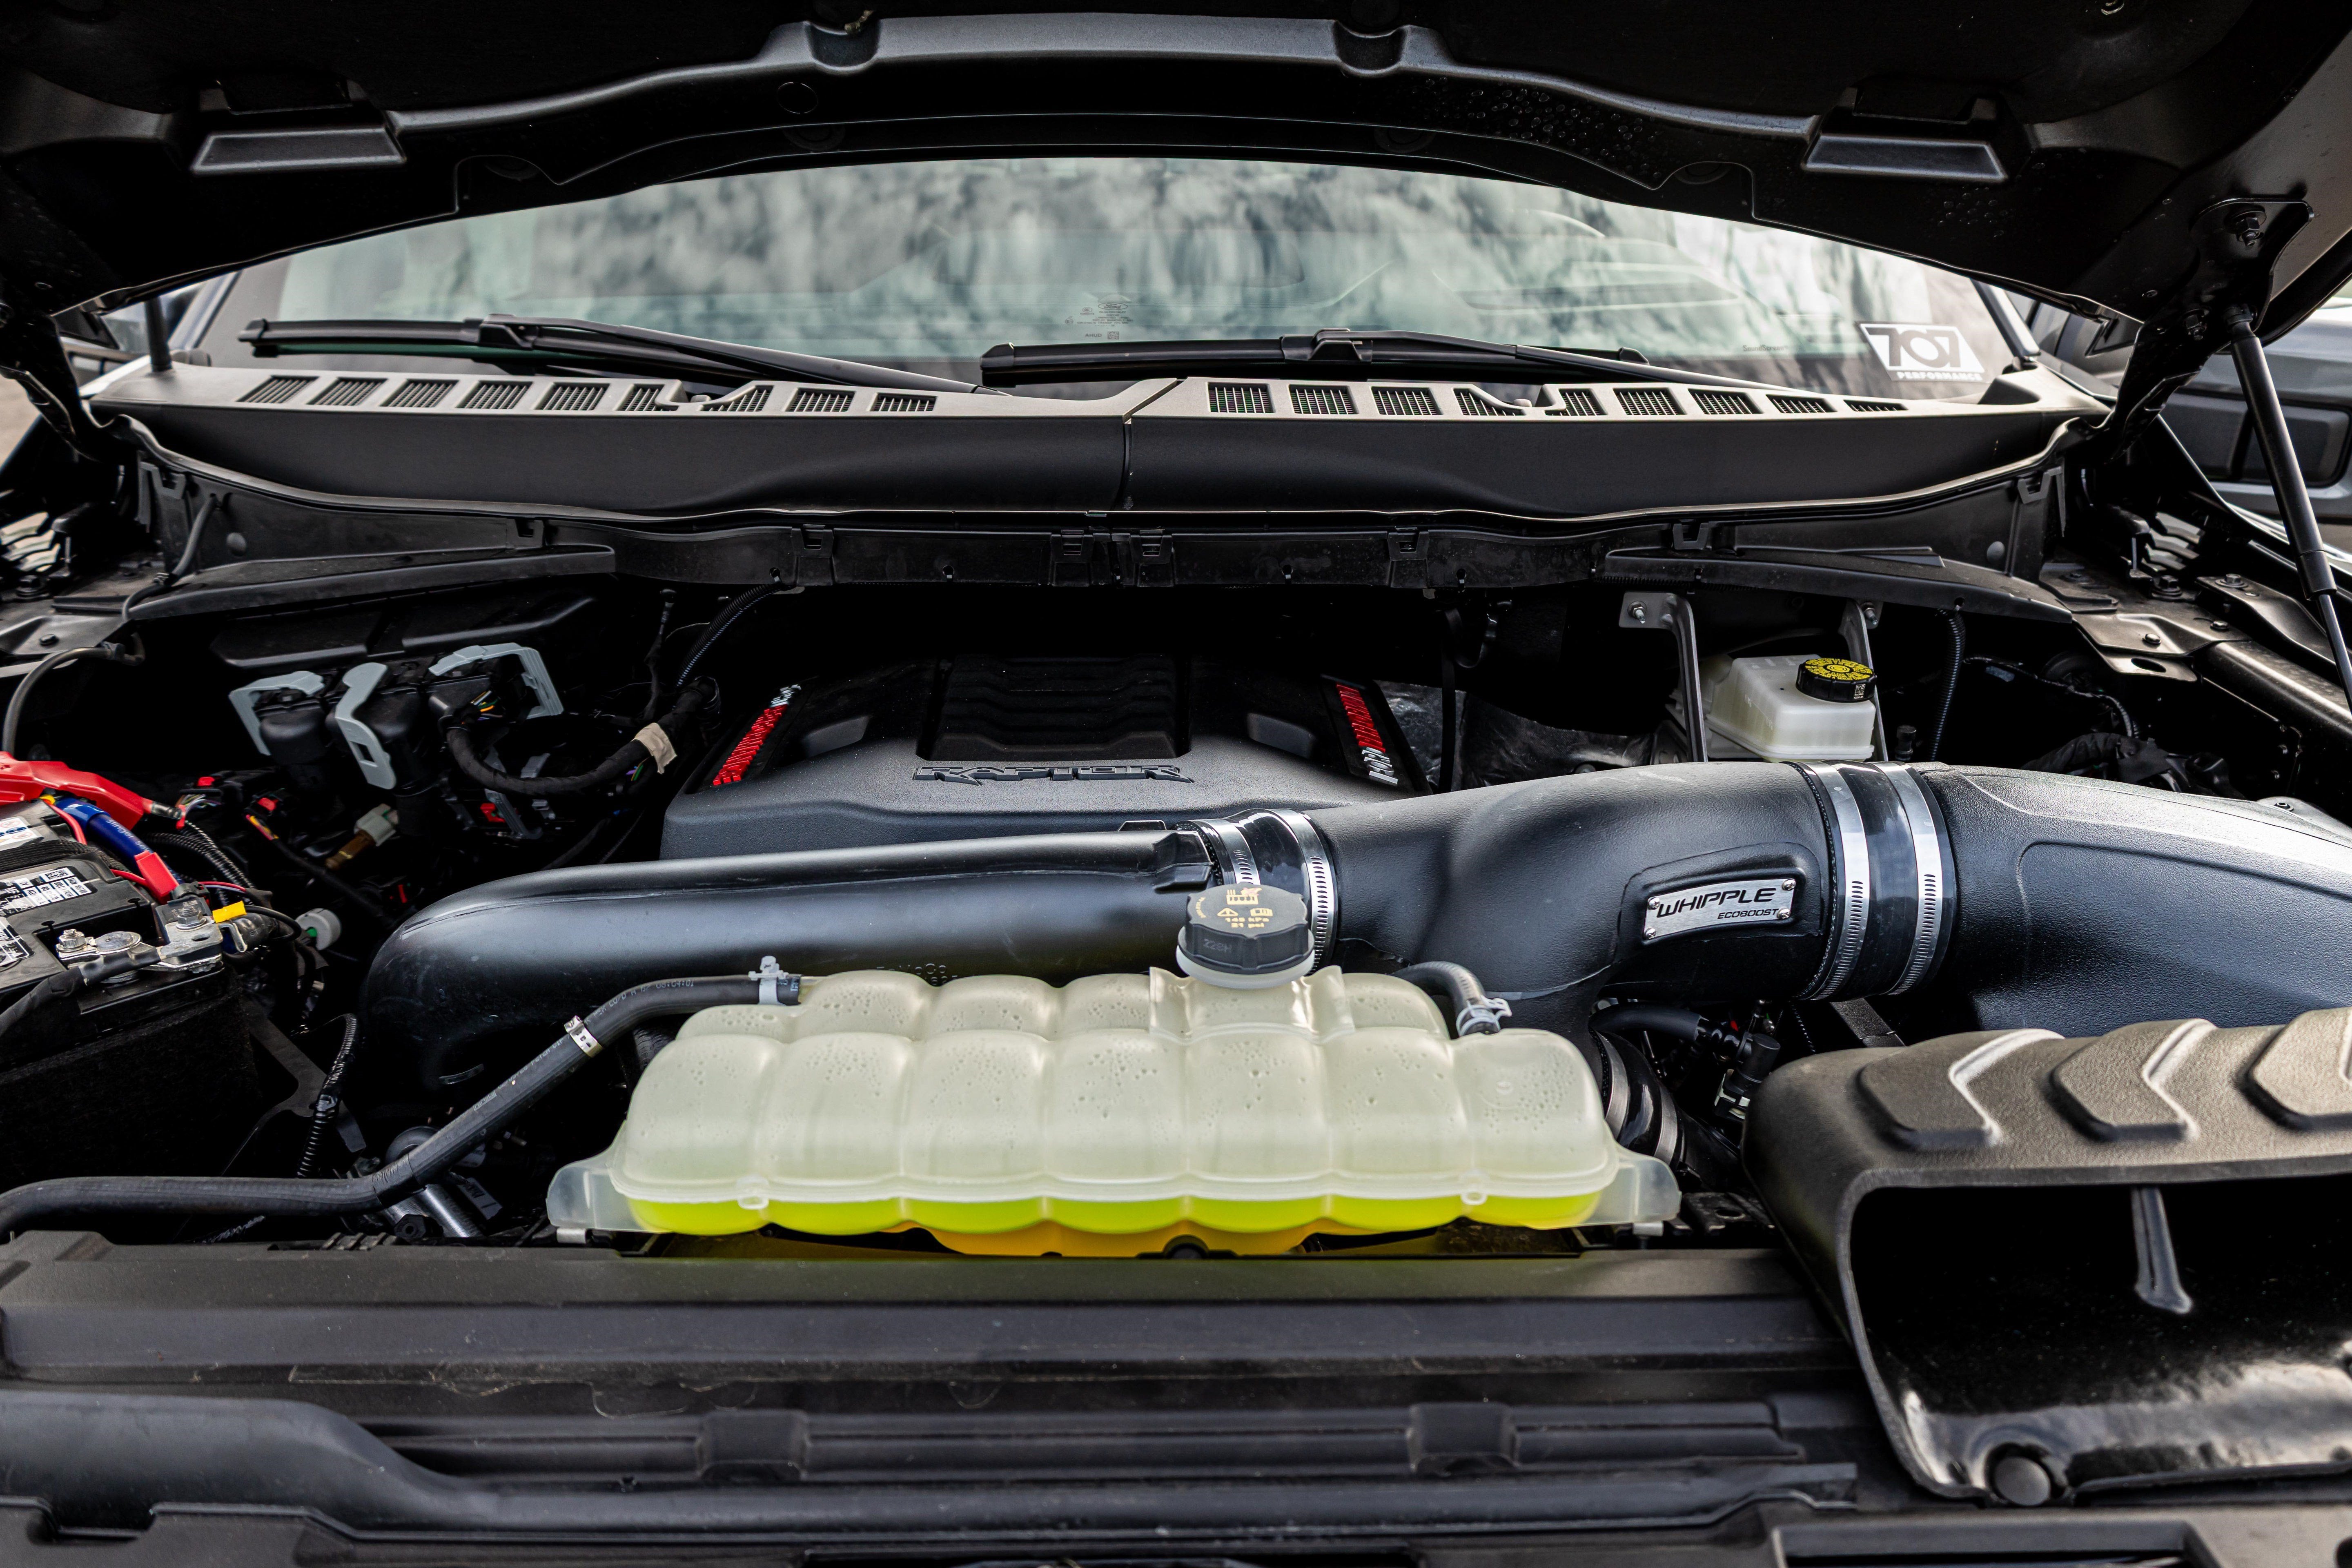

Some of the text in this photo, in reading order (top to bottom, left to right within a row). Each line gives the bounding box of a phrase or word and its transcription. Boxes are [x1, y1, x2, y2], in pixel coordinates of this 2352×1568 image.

[1897, 371, 1982, 381] PERFORMANCE
[913, 765, 1194, 786] RAPTOR
[1361, 747, 1398, 784] FORD
[1656, 888, 1777, 918] WHIPPLE
[1717, 909, 1779, 919] ECOBOOST
